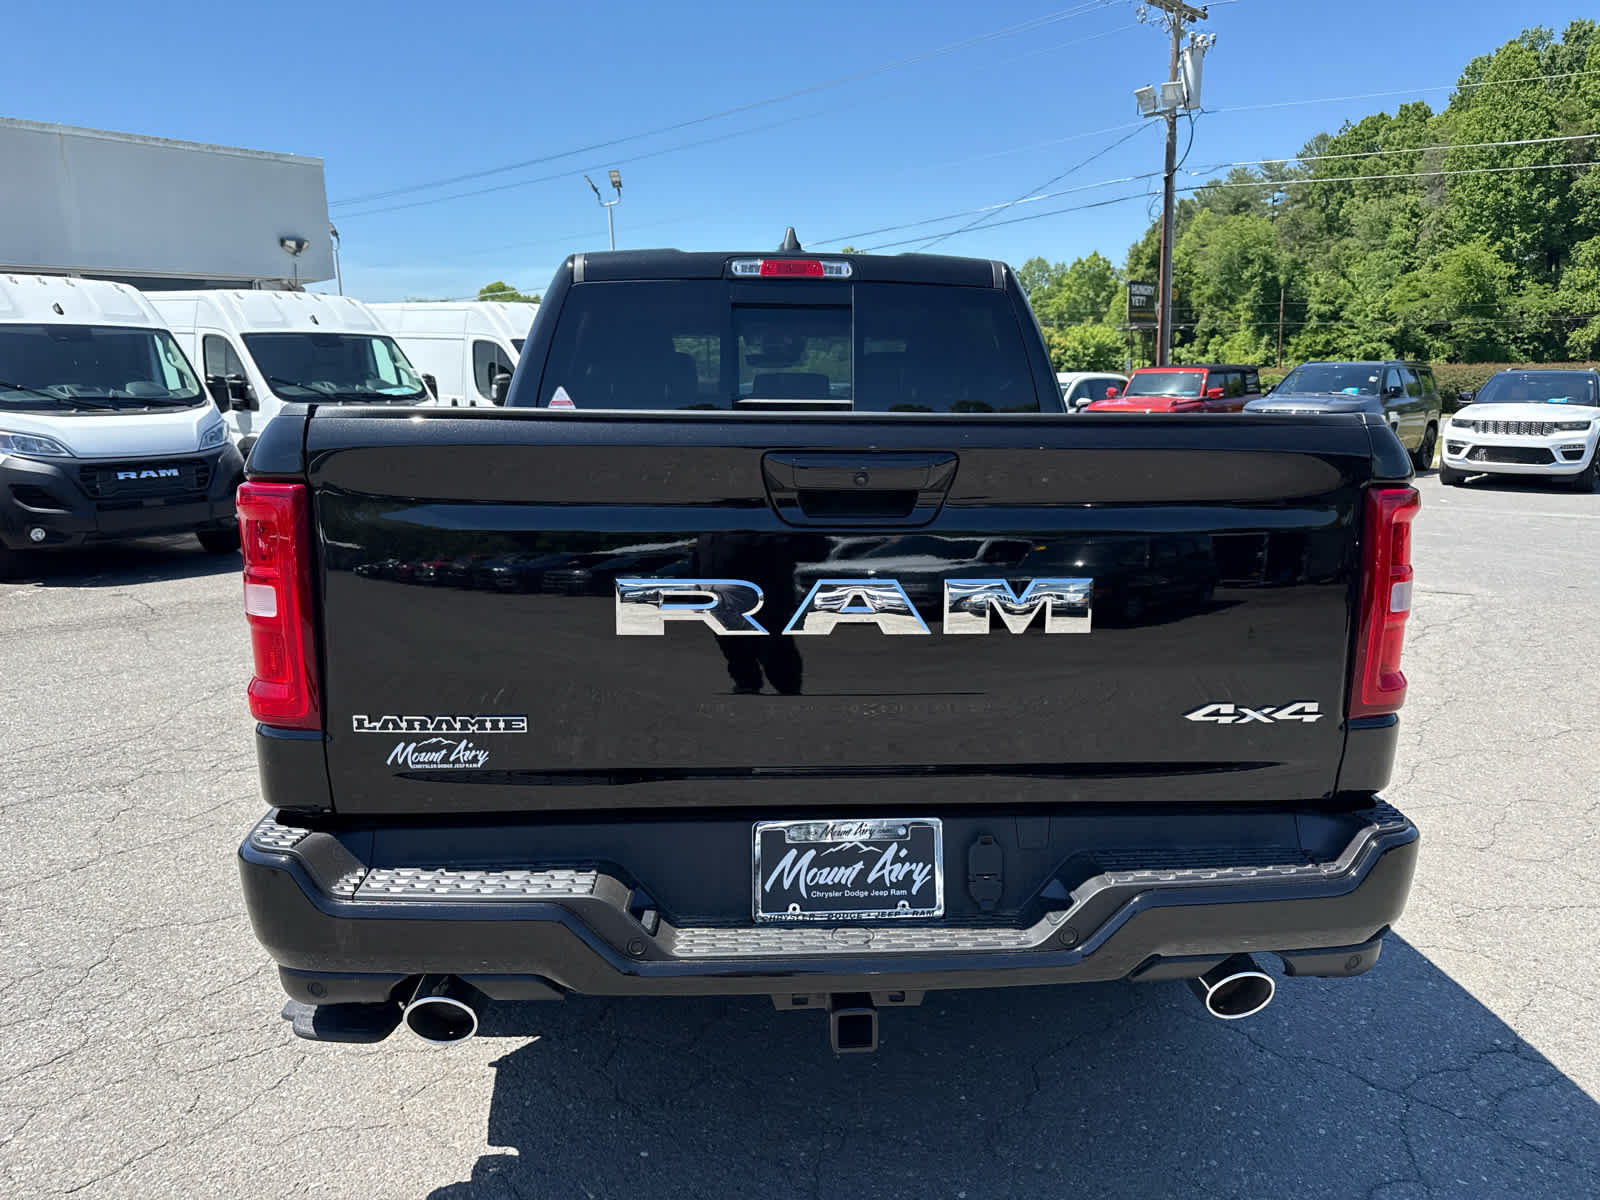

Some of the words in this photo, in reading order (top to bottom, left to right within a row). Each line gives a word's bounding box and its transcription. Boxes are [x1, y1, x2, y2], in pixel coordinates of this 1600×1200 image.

[117, 468, 179, 480] RAM
[615, 578, 1093, 636] RAM
[352, 715, 528, 733] LARAMIE
[386, 741, 447, 768] Mount
[449, 739, 489, 768] Airy
[819, 824, 852, 838] Mount
[853, 822, 874, 839] Airy
[764, 849, 864, 899] Mount
[866, 841, 932, 895] Airy
[810, 890, 843, 898] Chrysler
[844, 890, 869, 898] Dodge
[870, 889, 889, 897] Jeep
[911, 910, 936, 918] RAM
